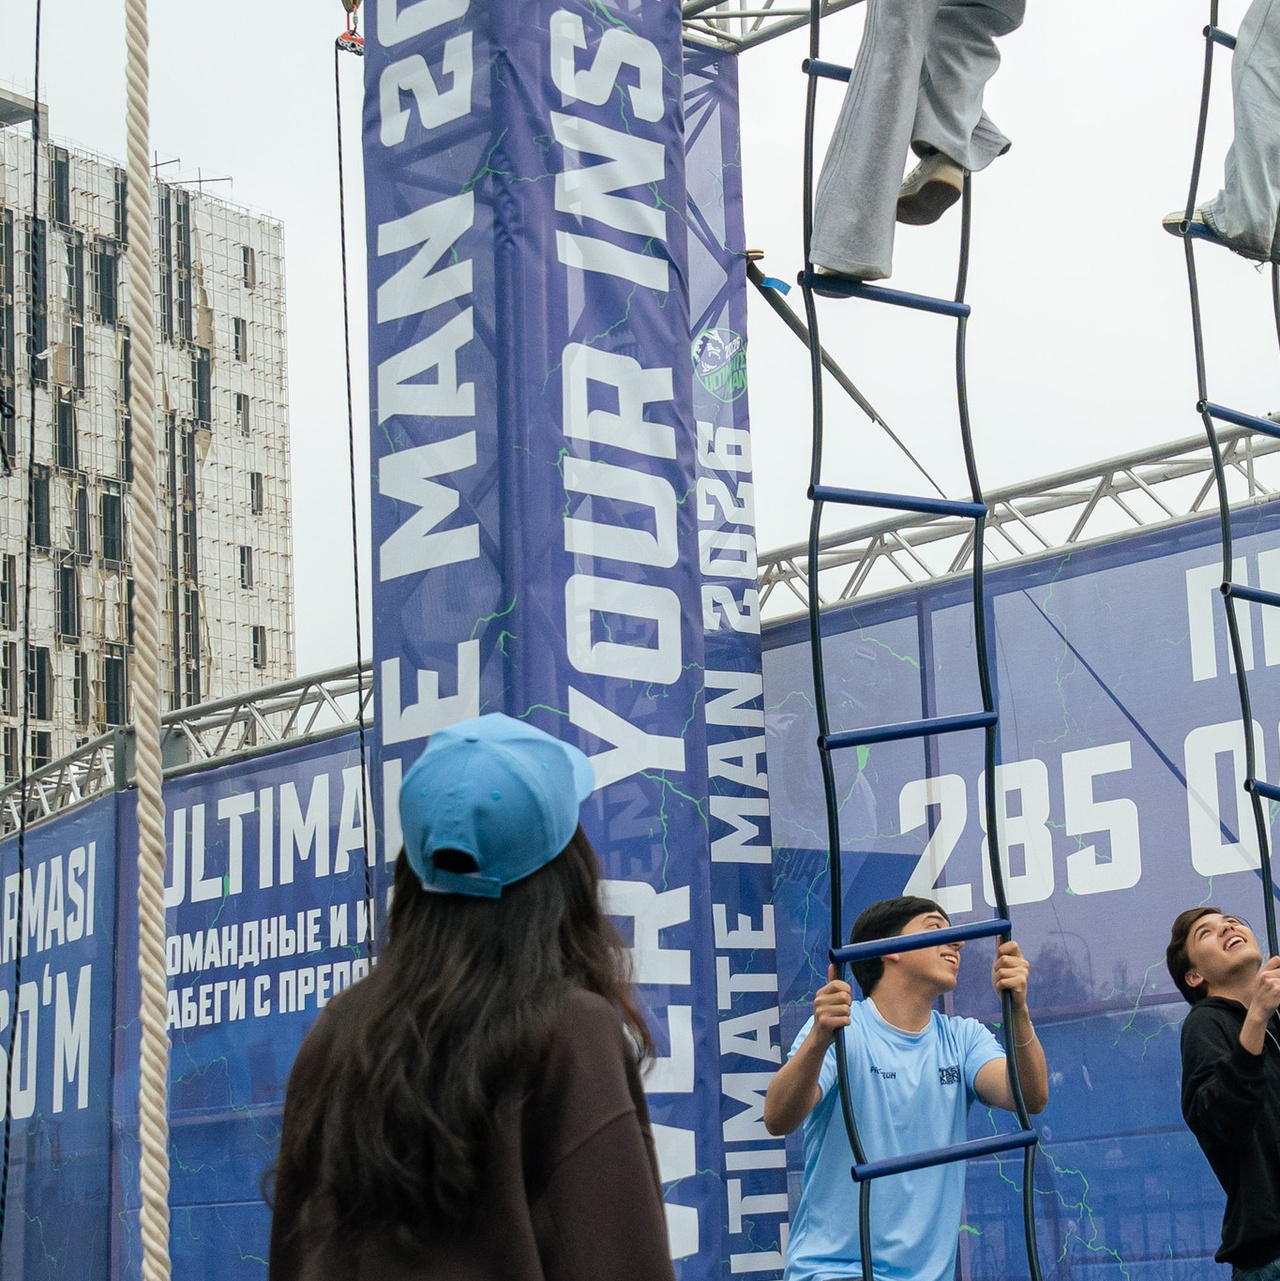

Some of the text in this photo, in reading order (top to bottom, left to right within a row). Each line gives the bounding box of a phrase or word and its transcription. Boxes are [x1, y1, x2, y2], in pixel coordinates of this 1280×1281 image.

[376, 190, 480, 582] MAN
[562, 341, 686, 792] YOUR
[696, 420, 760, 635] 2026
[705, 671, 773, 865] MAN
[898, 740, 1142, 914] 285
[0, 841, 96, 964] RMASI
[165, 908, 322, 977] ОМАНДНЫЕ
[166, 978, 246, 1031] АБЕГИ
